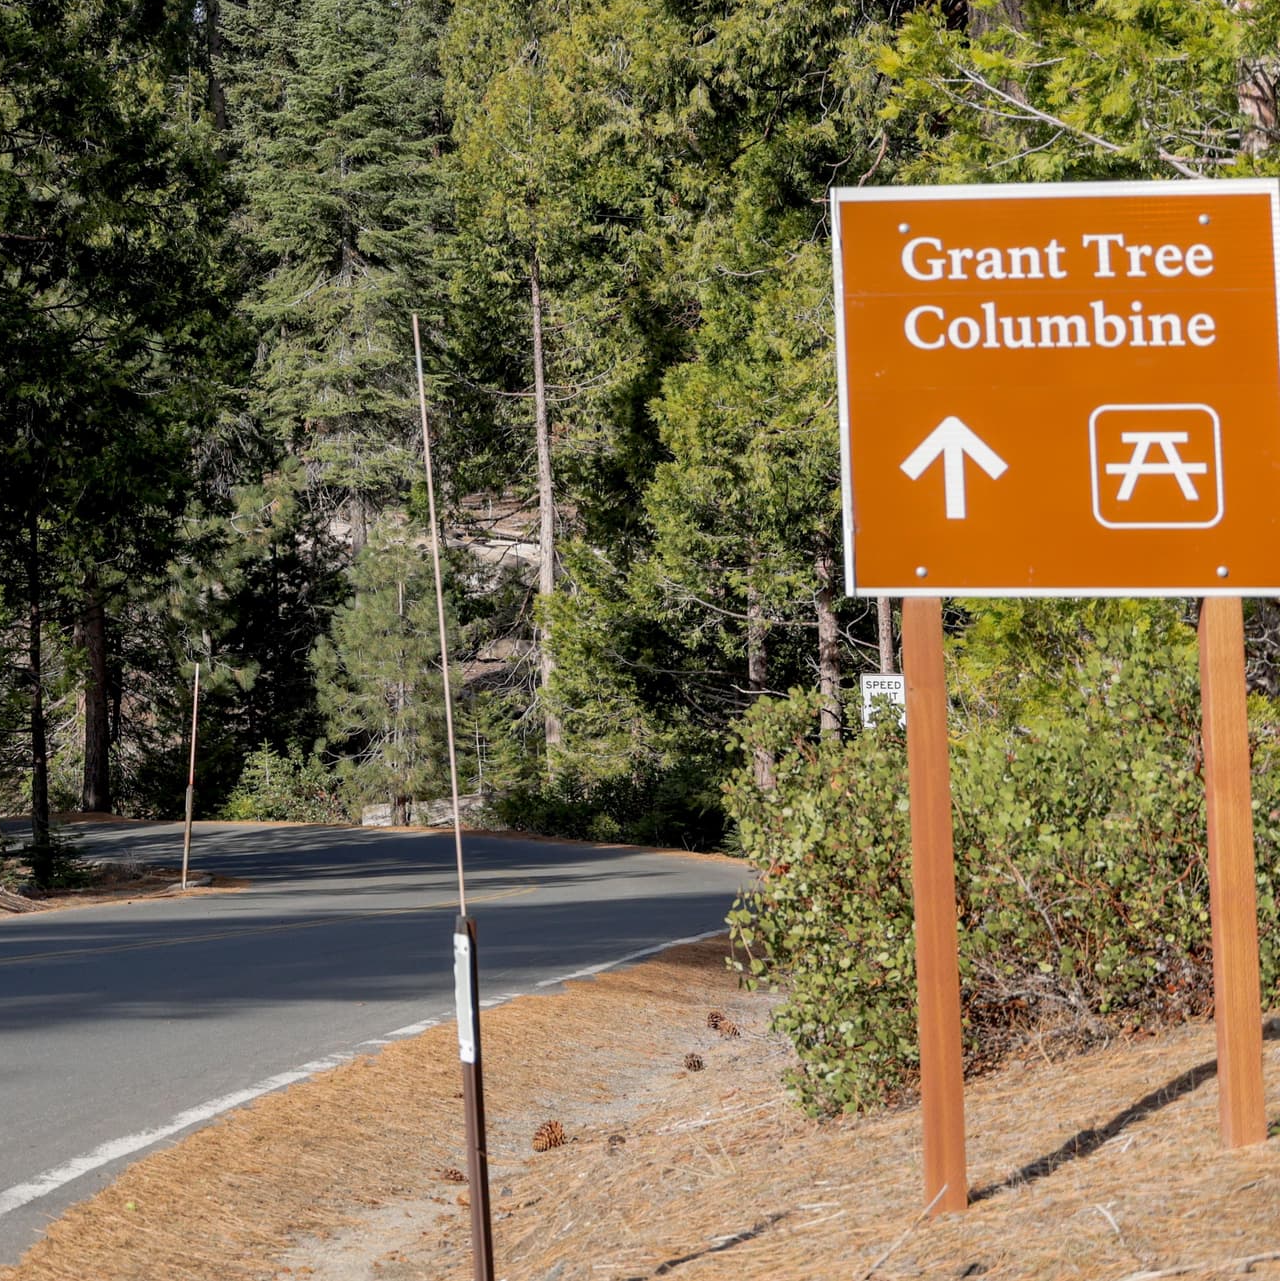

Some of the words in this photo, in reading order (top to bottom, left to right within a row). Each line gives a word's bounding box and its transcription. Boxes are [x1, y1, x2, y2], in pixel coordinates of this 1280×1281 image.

[900, 236, 1067, 281] Grant
[1082, 233, 1215, 278] Tree
[903, 300, 1217, 350] Columbine
[865, 680, 901, 690] SPEED
